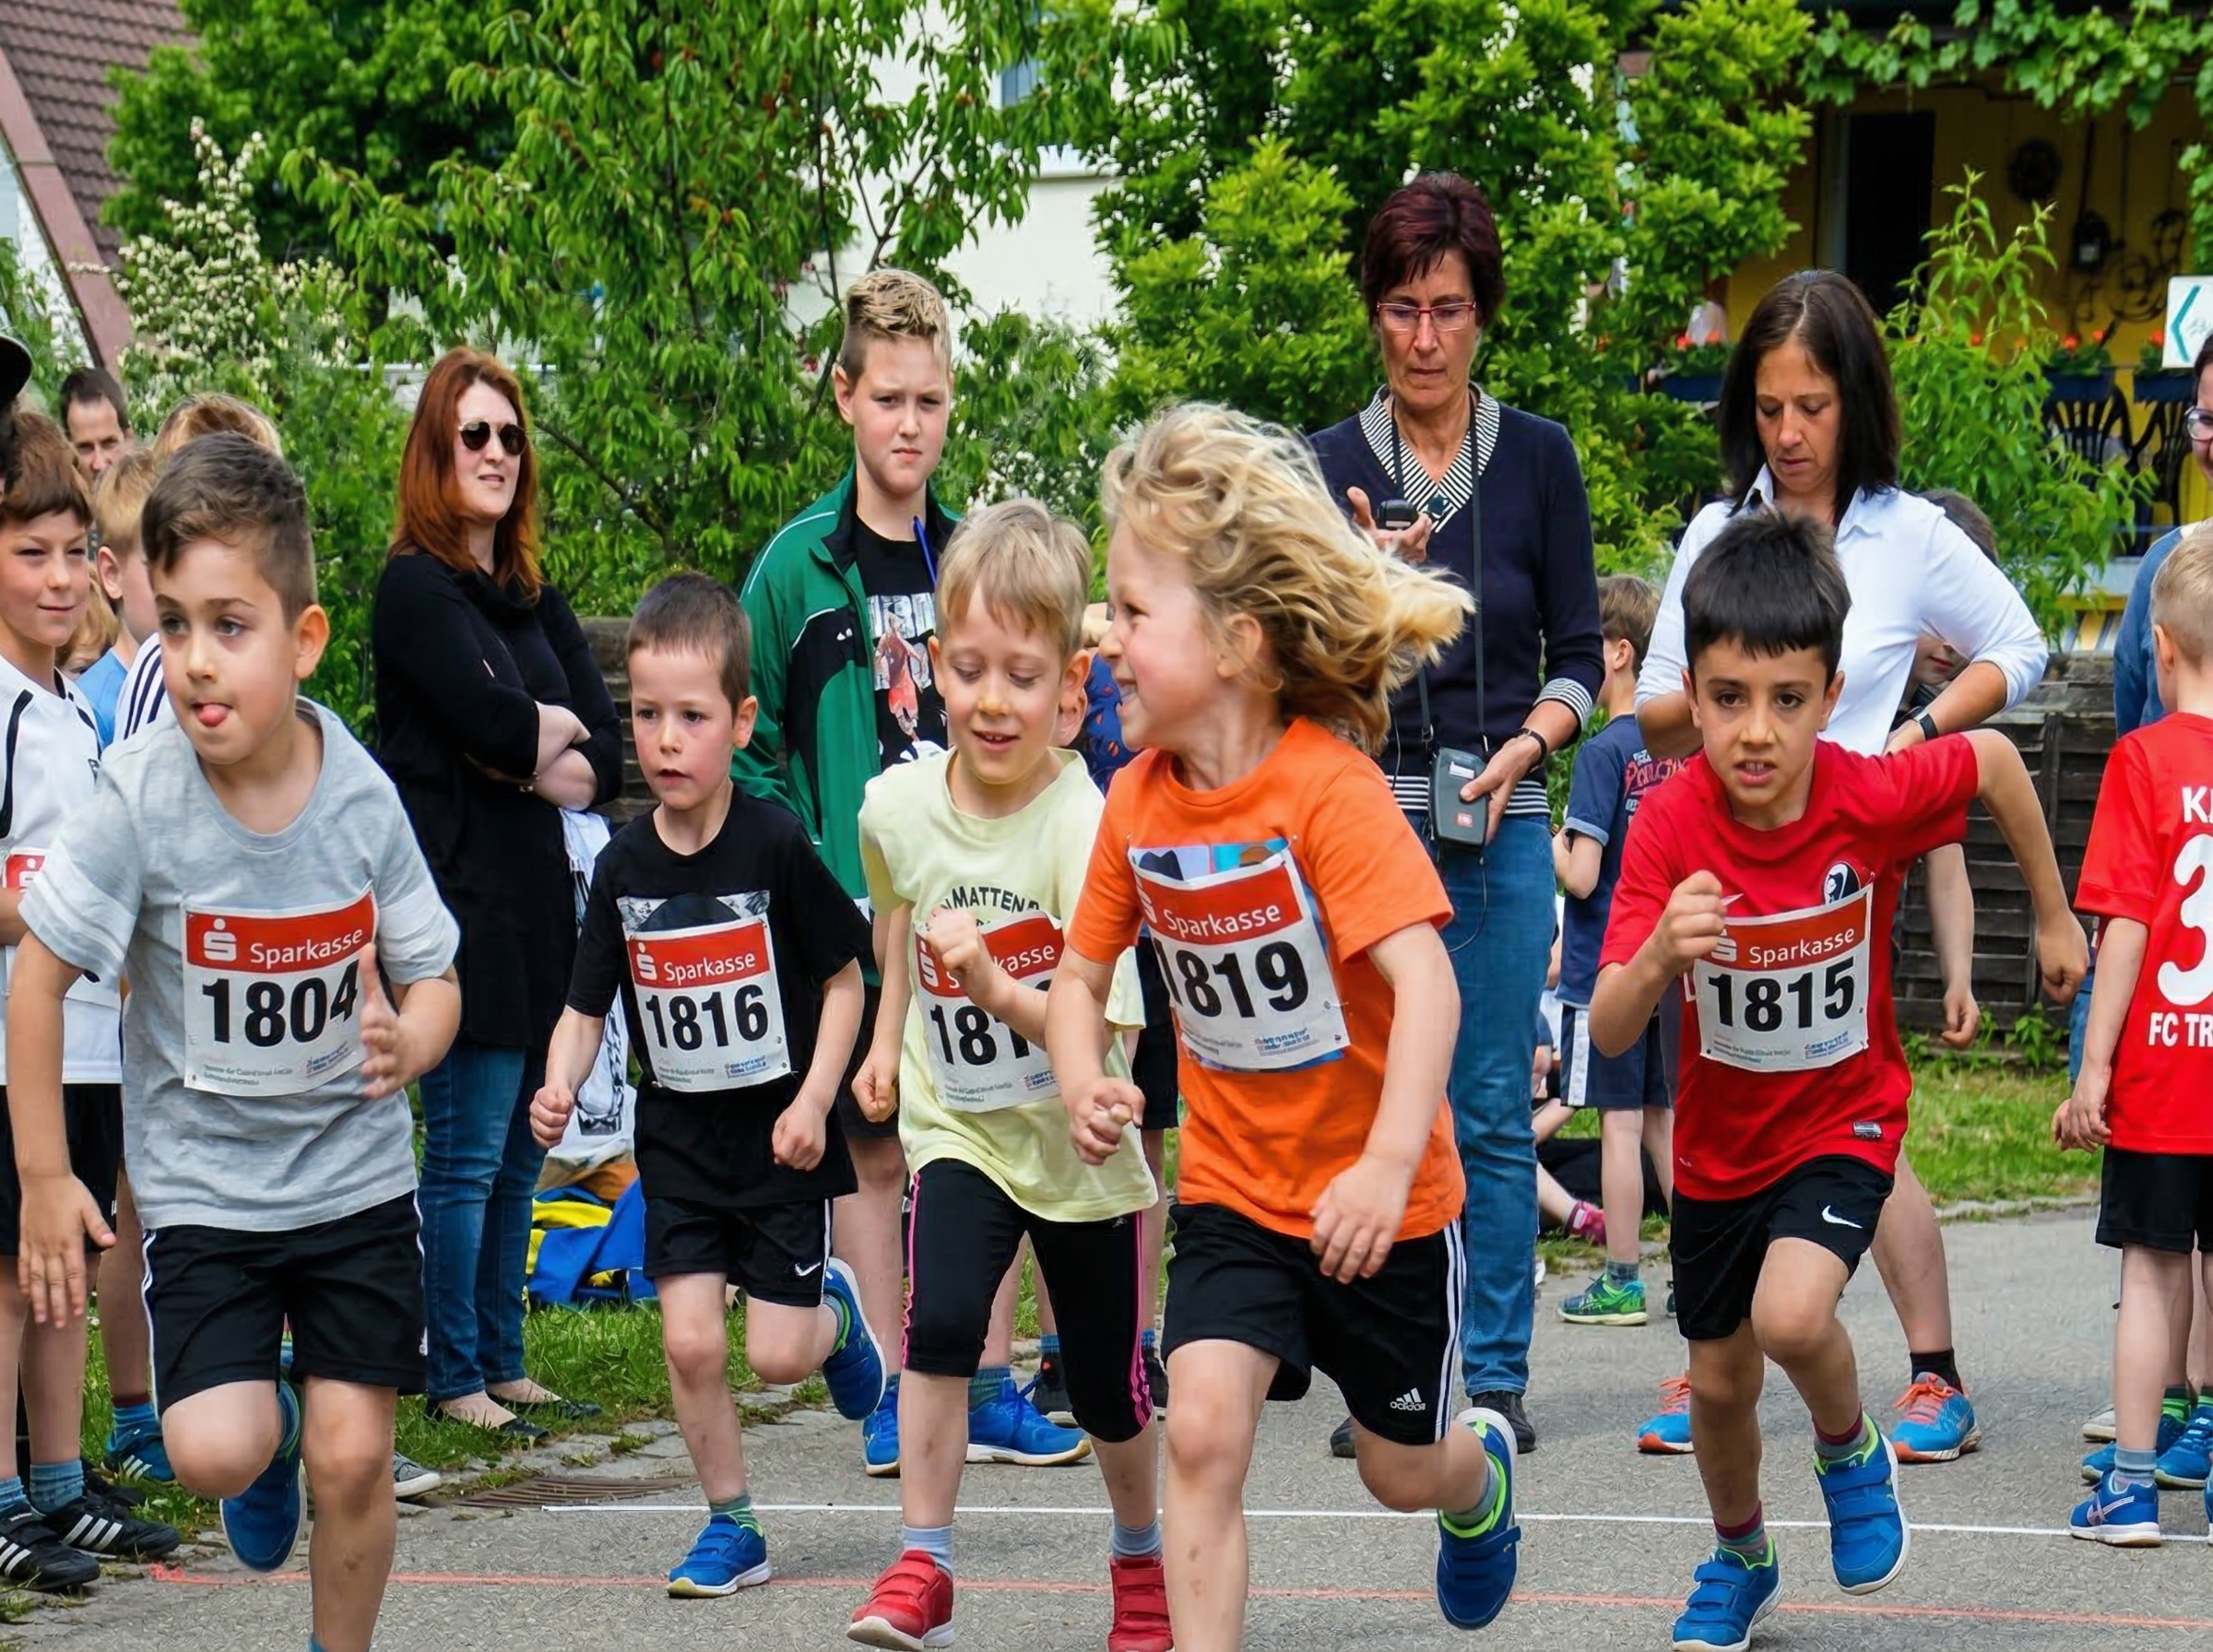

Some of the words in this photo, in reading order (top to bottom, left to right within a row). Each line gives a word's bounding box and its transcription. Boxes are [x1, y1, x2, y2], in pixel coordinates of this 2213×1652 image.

[2182, 785, 2213, 823] K
[1163, 903, 1282, 938] Sparkasse
[2157, 833, 2213, 1006] 3
[250, 929, 363, 969] Sparkasse
[663, 952, 756, 985] Sparkasse
[946, 945, 1055, 989] Skasse
[1749, 927, 1855, 968] Sparkasse
[1153, 938, 1308, 1018] 1819
[1708, 956, 1854, 1032] 1815
[202, 959, 360, 1047] 1804
[645, 984, 769, 1051] 1816
[2148, 1012, 2179, 1047] FC
[2184, 1013, 2213, 1047] TR
